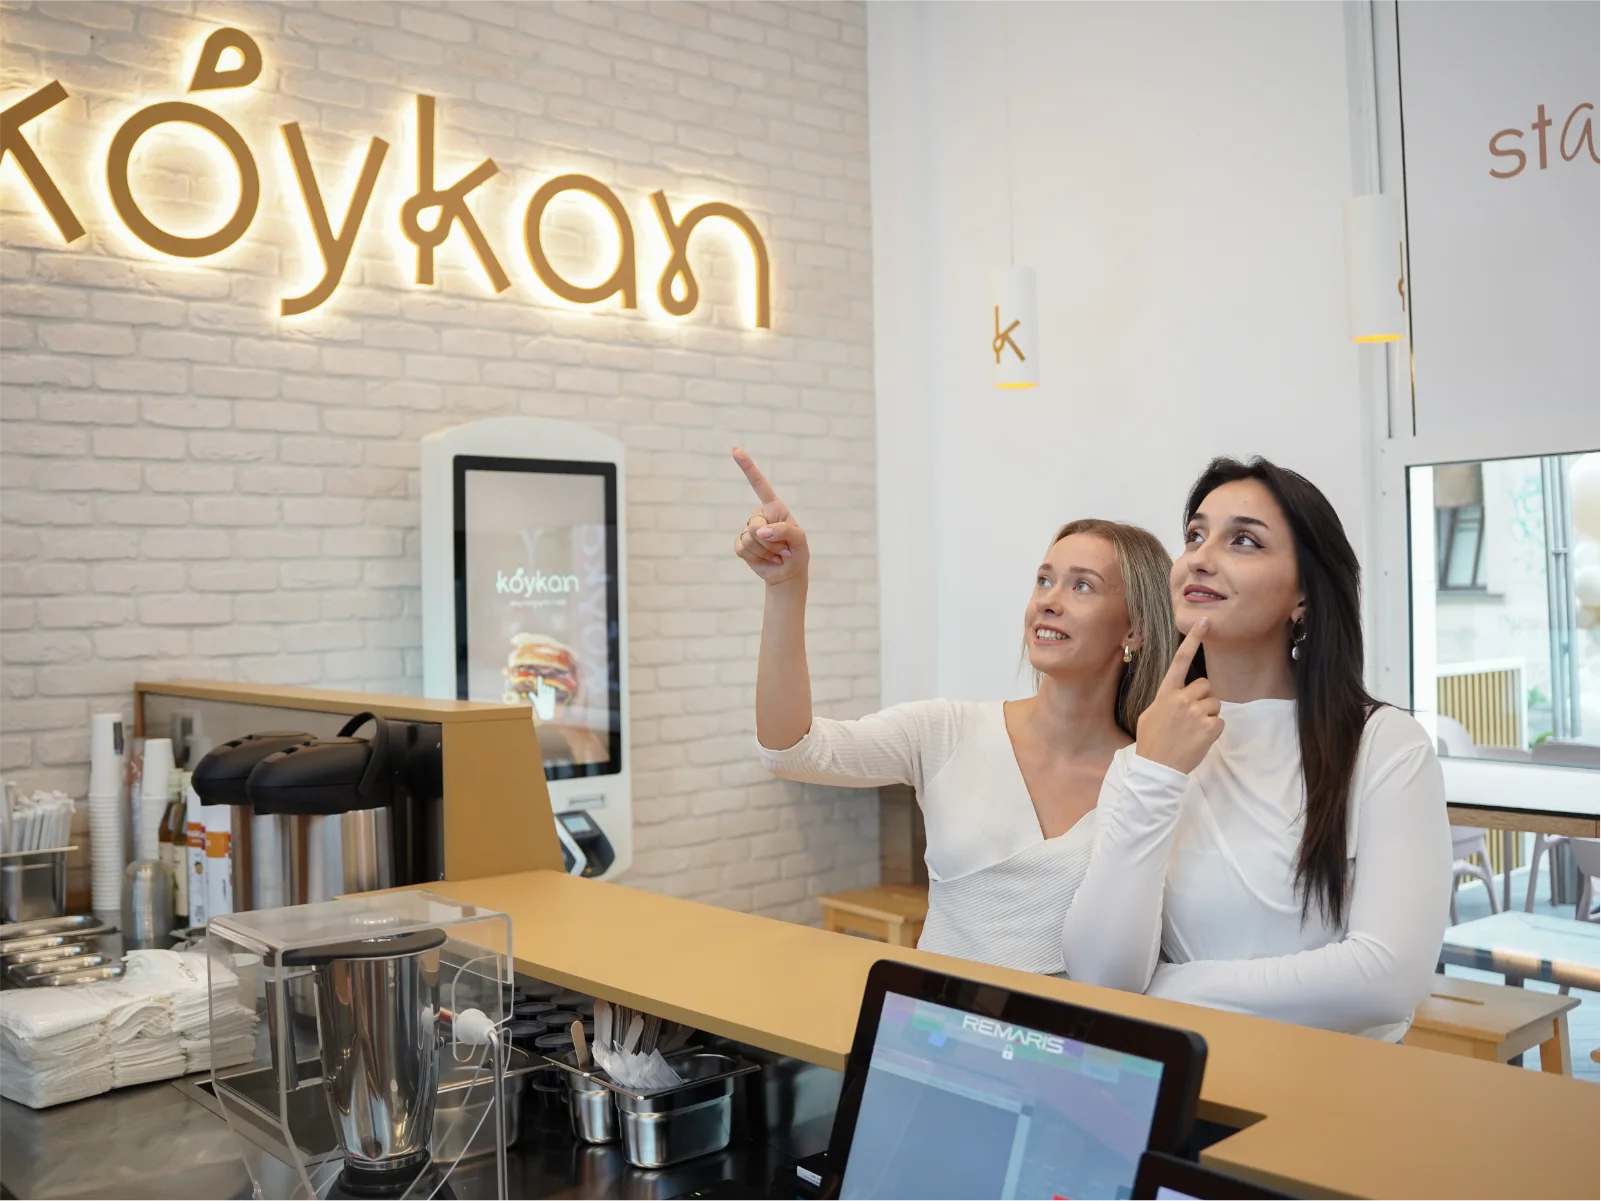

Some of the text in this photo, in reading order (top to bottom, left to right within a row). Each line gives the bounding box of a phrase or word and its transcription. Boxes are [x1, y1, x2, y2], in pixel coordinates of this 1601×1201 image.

[1488, 102, 1601, 179] sta
[496, 567, 580, 598] kóykan
[962, 1014, 1065, 1054] REMARIS
